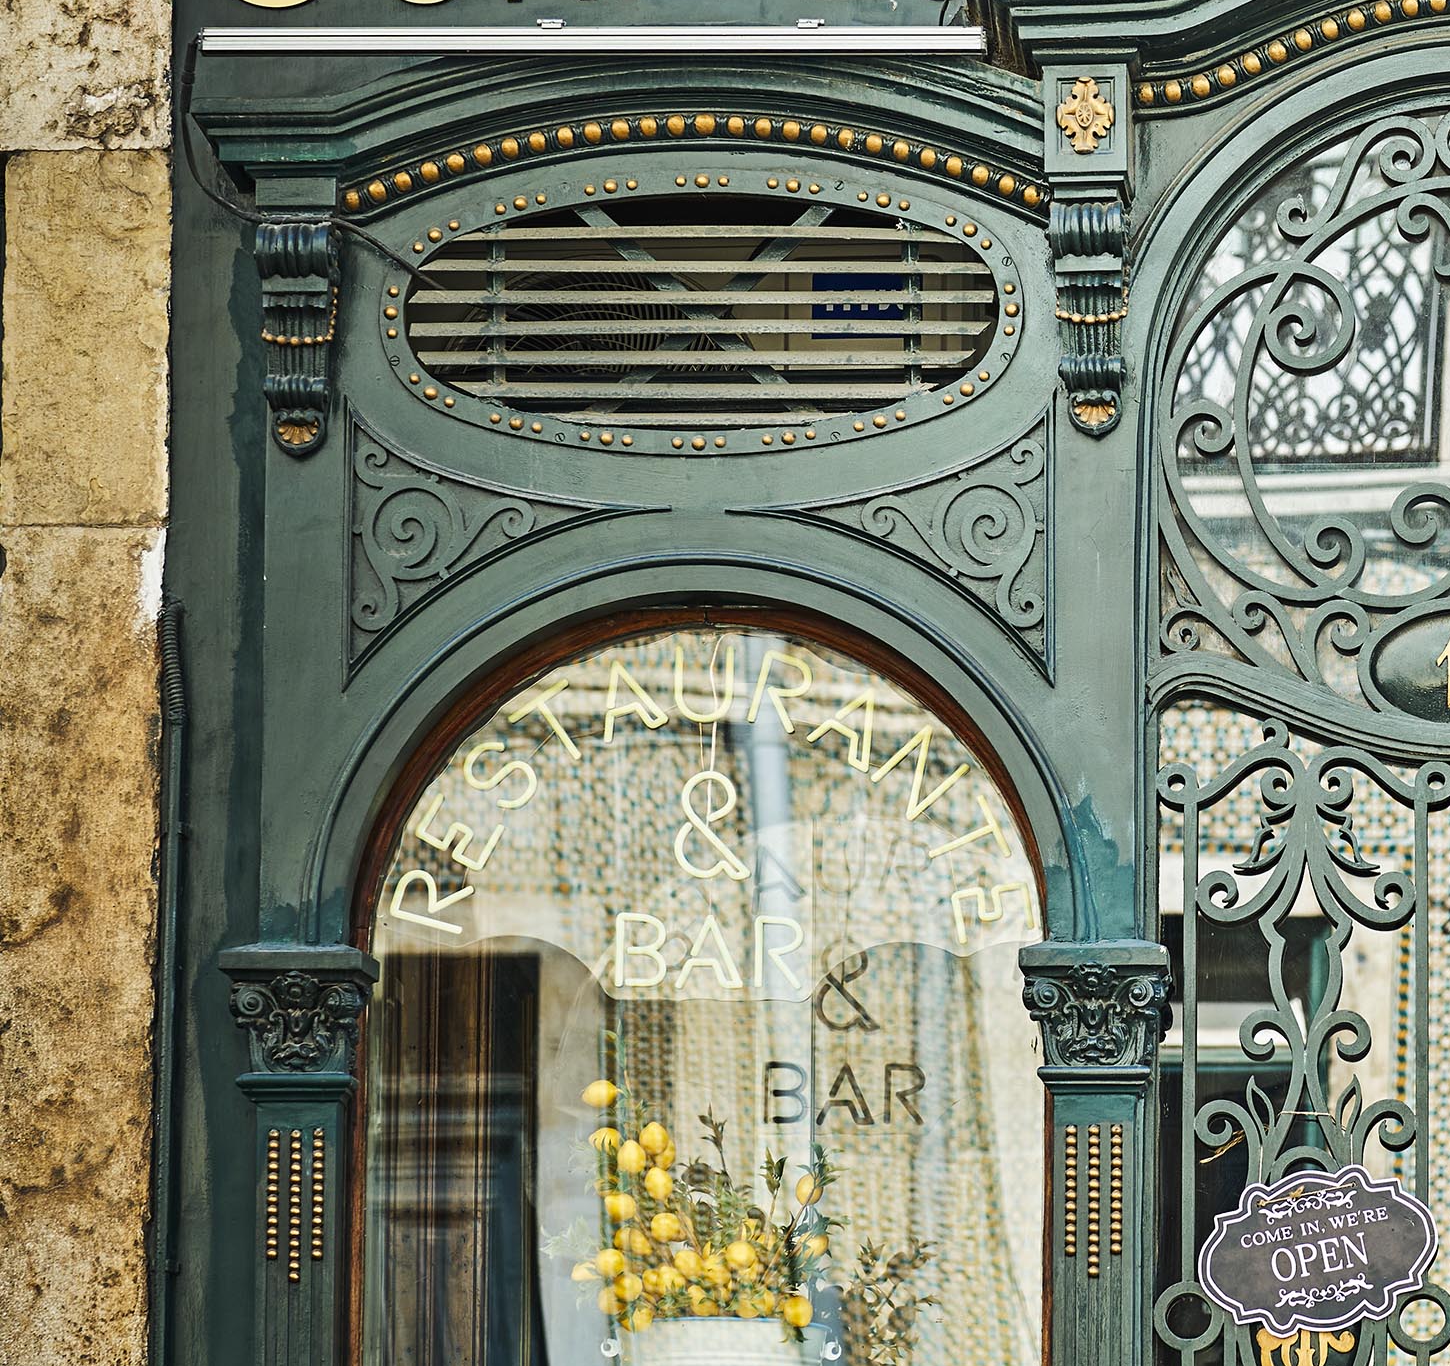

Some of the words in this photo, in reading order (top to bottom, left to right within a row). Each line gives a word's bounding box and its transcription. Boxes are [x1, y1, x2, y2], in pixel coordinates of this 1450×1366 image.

[390, 645, 1035, 944] RESTAURANTE
[673, 770, 751, 881] &
[613, 912, 803, 990] BAR
[1240, 1225, 1294, 1249] COME
[1299, 1219, 1326, 1237] IN,
[1327, 1206, 1389, 1230] WE'RE
[1270, 1231, 1369, 1282] OPEN
